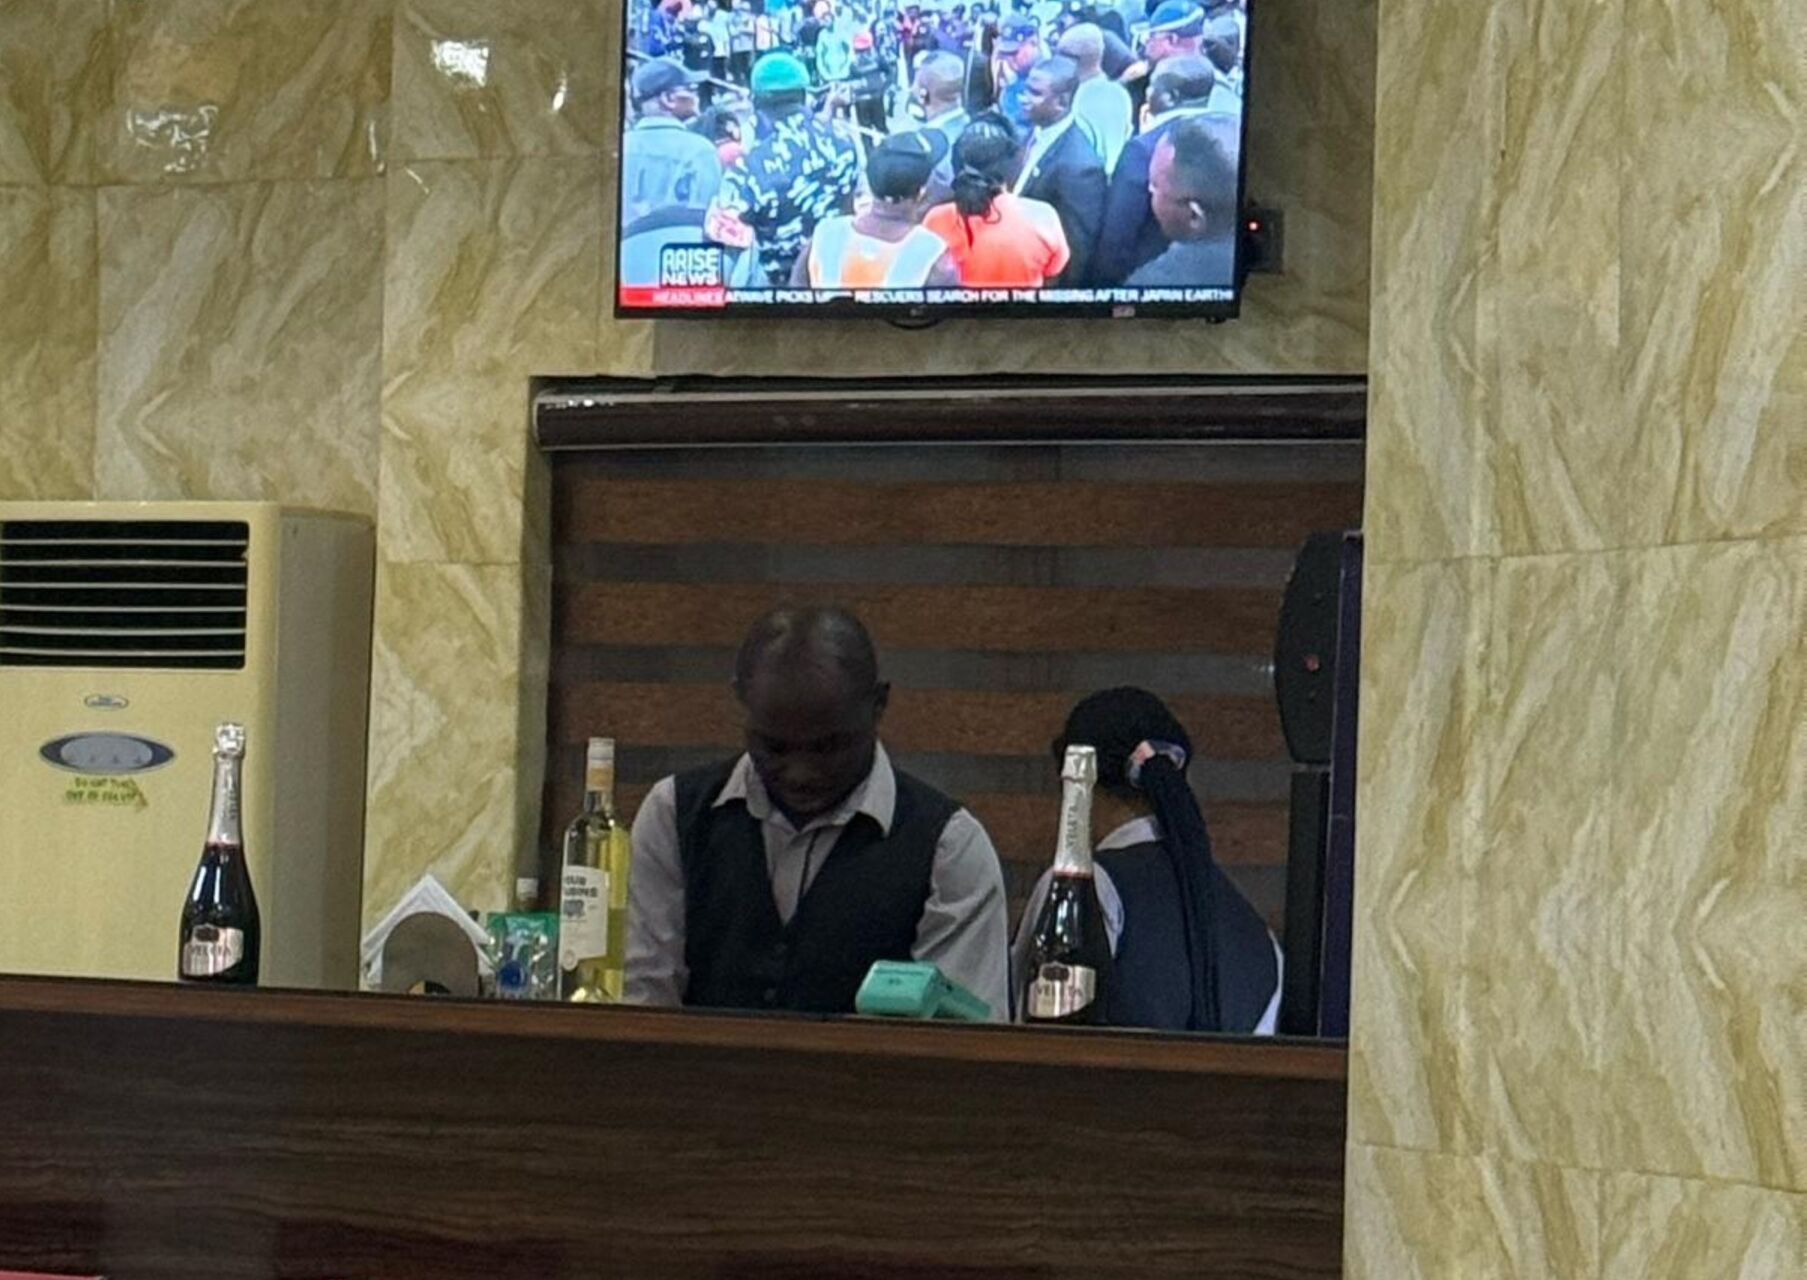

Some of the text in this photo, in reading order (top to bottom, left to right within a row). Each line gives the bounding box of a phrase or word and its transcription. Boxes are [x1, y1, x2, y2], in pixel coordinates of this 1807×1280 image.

[663, 248, 721, 271] ARISE
[663, 271, 720, 286] NEWS
[855, 290, 924, 303] RESCUERS
[927, 290, 979, 303] SEARCH
[982, 290, 1008, 303] FOR
[1013, 290, 1036, 303] THE
[1096, 289, 1138, 302] AFTER
[1141, 289, 1182, 302] JAPAN
